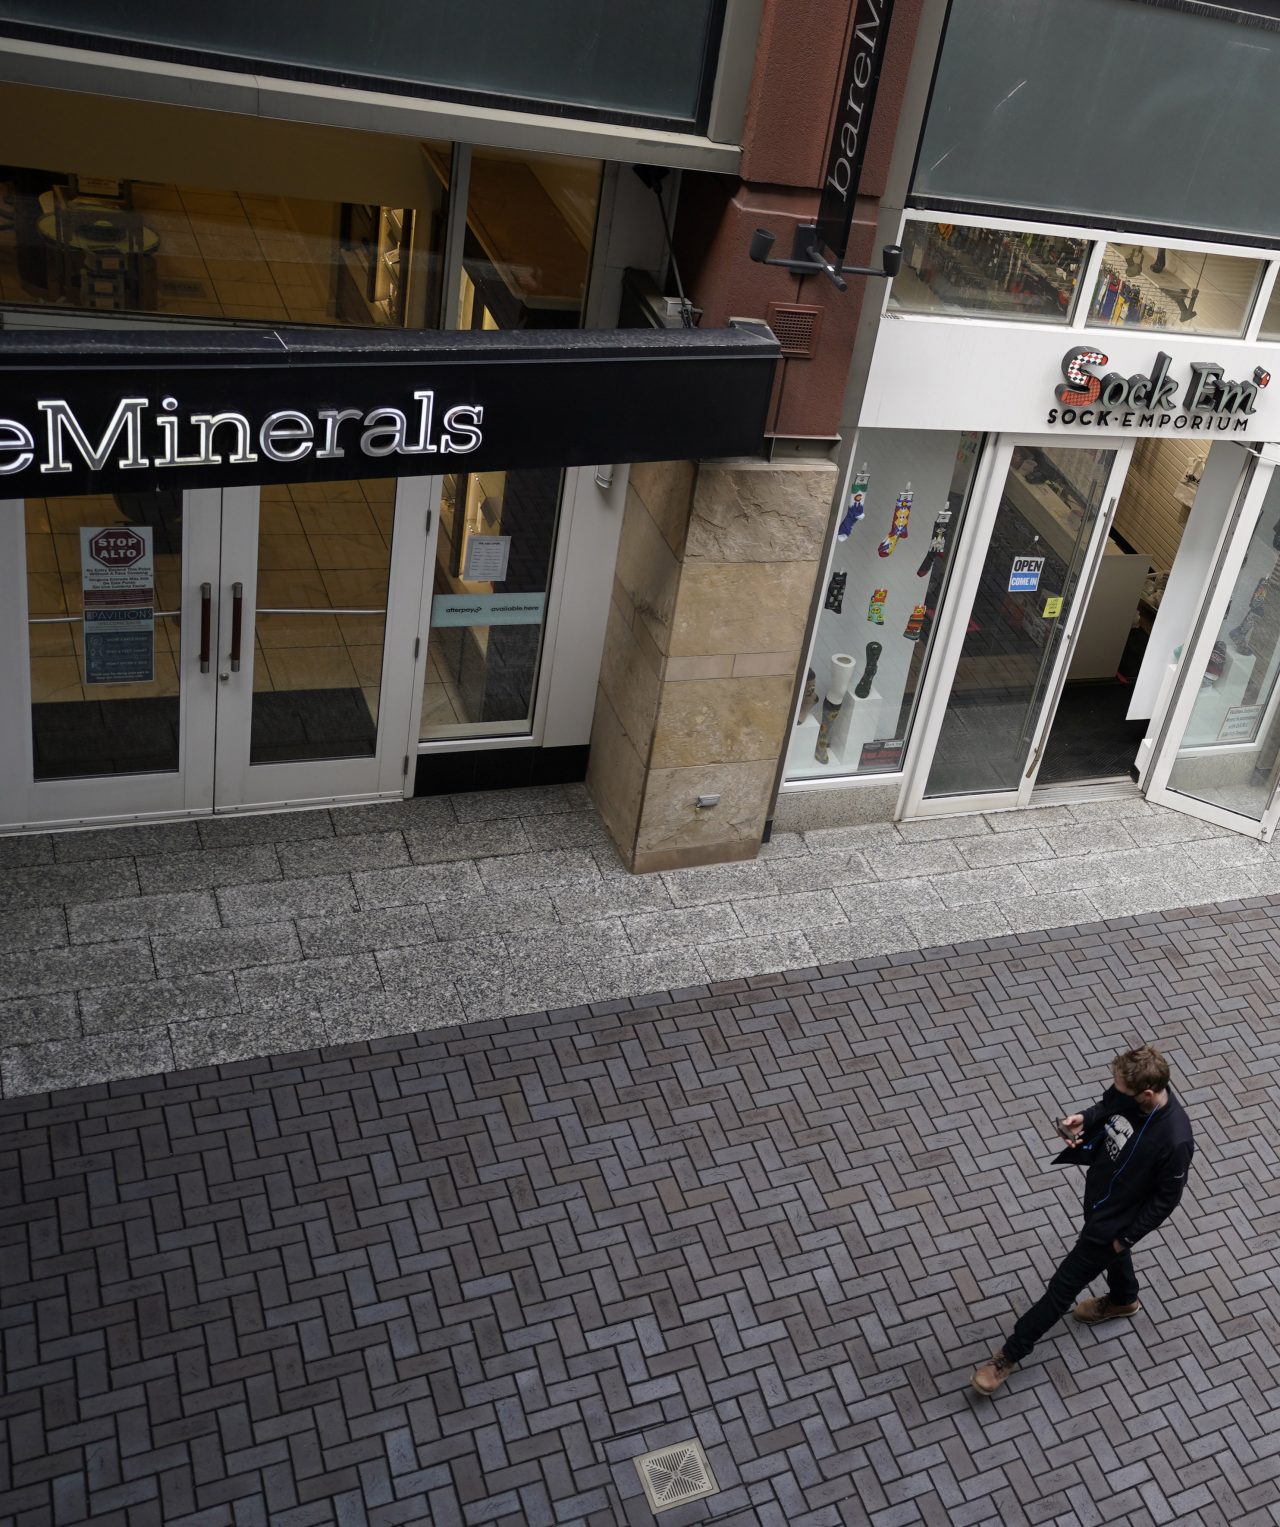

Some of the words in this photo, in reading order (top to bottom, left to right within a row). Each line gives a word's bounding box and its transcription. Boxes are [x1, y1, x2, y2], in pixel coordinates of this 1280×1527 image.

[1054, 345, 1179, 411] Sock
[98, 538, 138, 548] STOP
[100, 549, 138, 559] ALTO
[1013, 559, 1043, 573] OPEN
[1011, 577, 1031, 586] COME
[1030, 577, 1038, 586] IN
[93, 610, 152, 620] PAVILIONS
